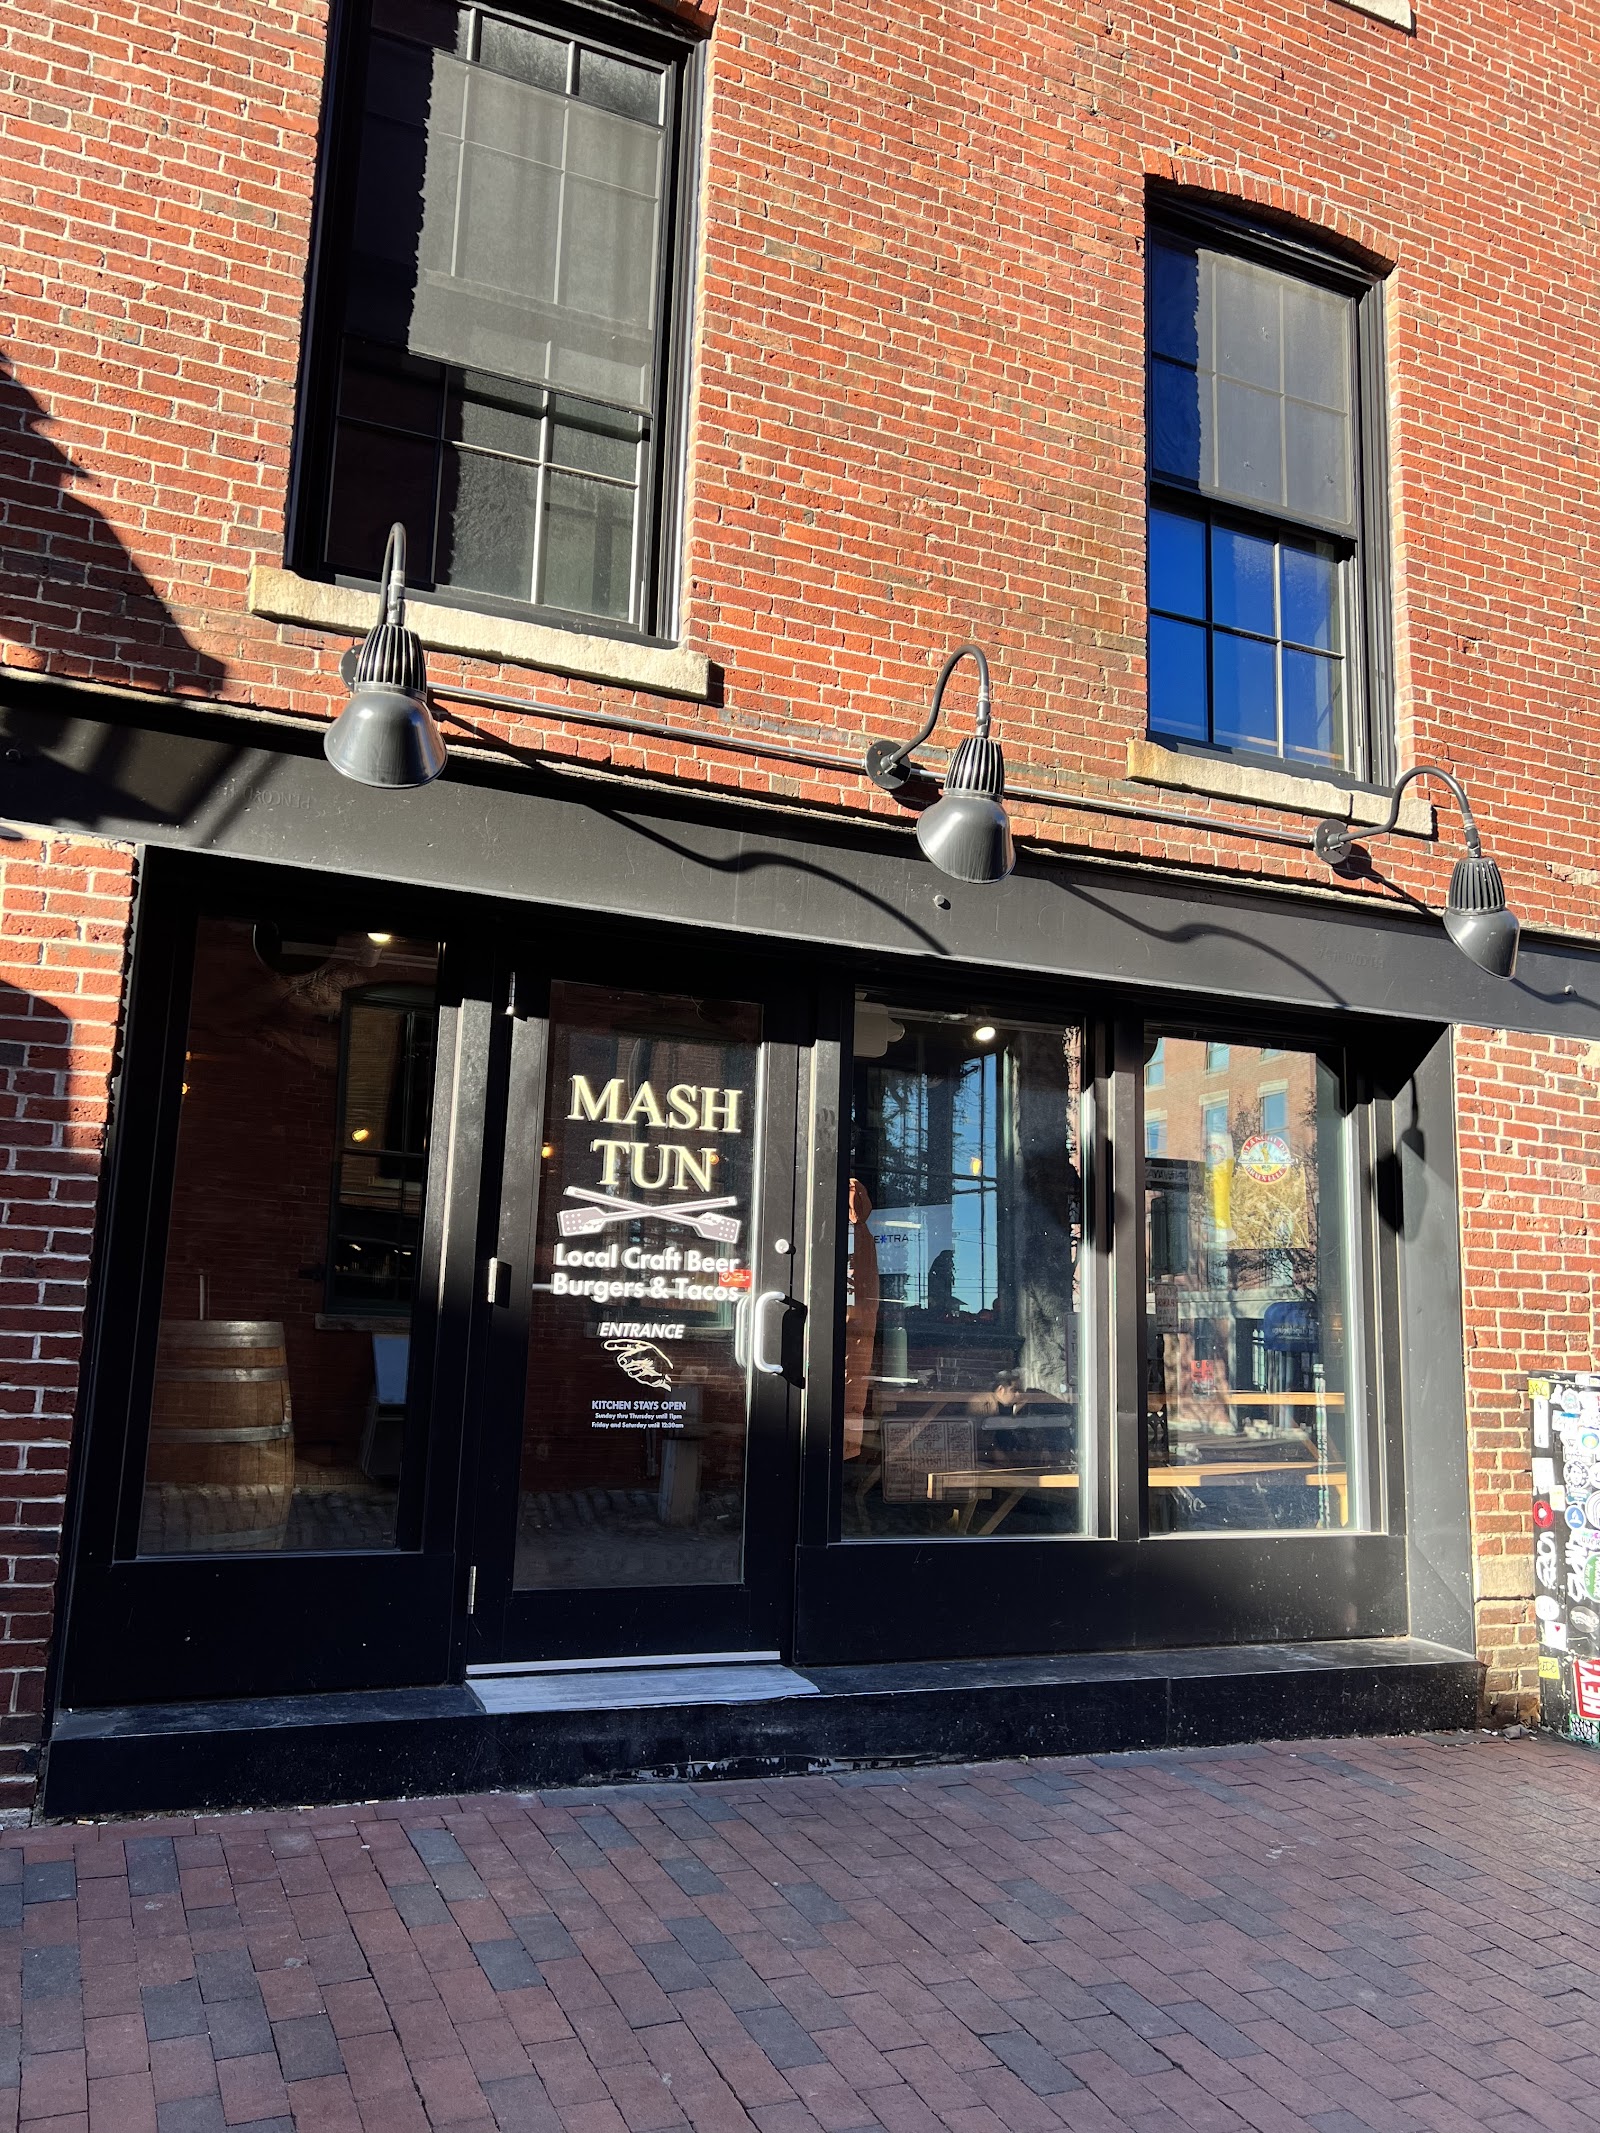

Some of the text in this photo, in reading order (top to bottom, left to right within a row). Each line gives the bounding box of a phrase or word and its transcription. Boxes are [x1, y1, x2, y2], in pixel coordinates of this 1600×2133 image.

[565, 1075, 743, 1133] MASH
[590, 1139, 717, 1192] TUN
[553, 1243, 741, 1273] Local Craft Beer
[552, 1272, 740, 1303] Burgers & Tacos
[597, 1322, 686, 1339] ENTRANCE
[591, 1400, 687, 1411] KITCHEN STAYS OPEN
